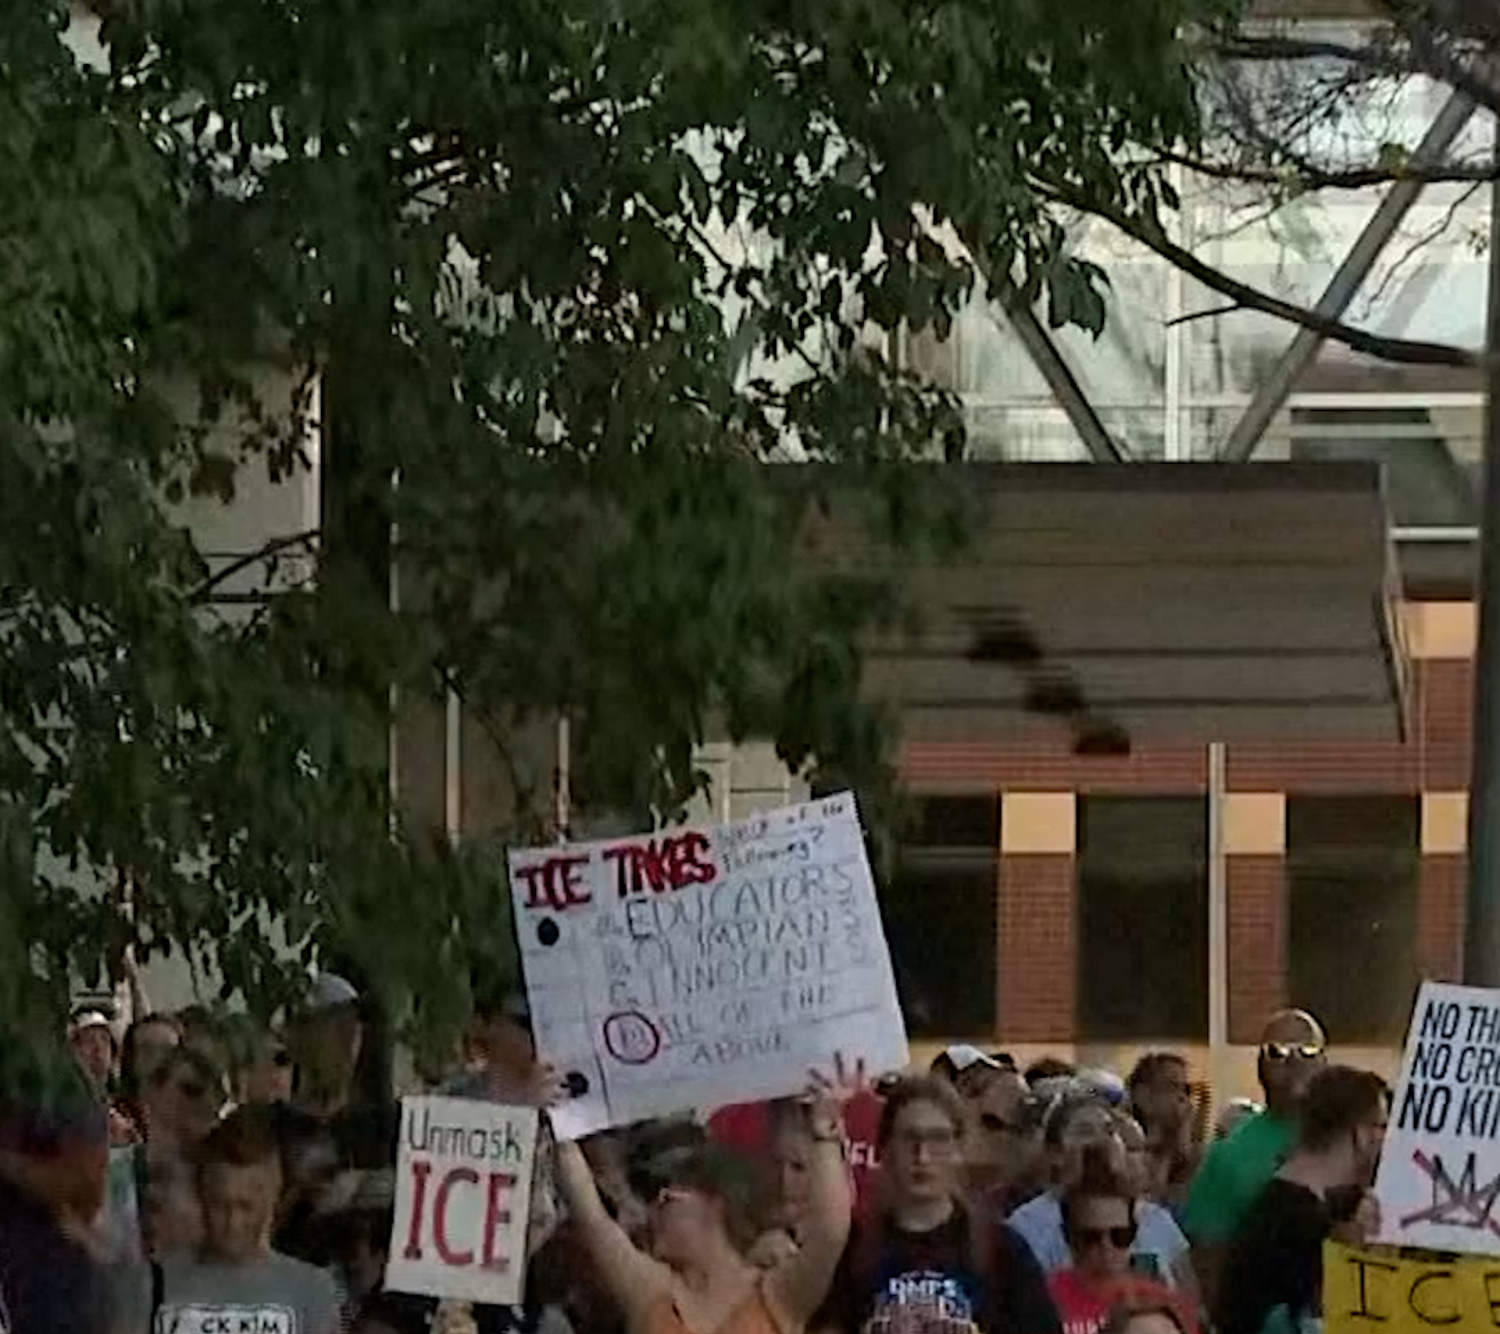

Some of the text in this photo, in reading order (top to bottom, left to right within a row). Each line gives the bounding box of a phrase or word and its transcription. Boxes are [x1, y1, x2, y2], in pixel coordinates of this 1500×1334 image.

[515, 831, 717, 911] ICE TAKES
[626, 863, 853, 941] EDUCATORS
[1420, 1002, 1460, 1040] NO
[1411, 1042, 1451, 1080] NO
[408, 1108, 521, 1162] Unmask
[1398, 1083, 1451, 1133] NO
[404, 1160, 517, 1271] ICE
[1347, 1256, 1500, 1329] ICE
